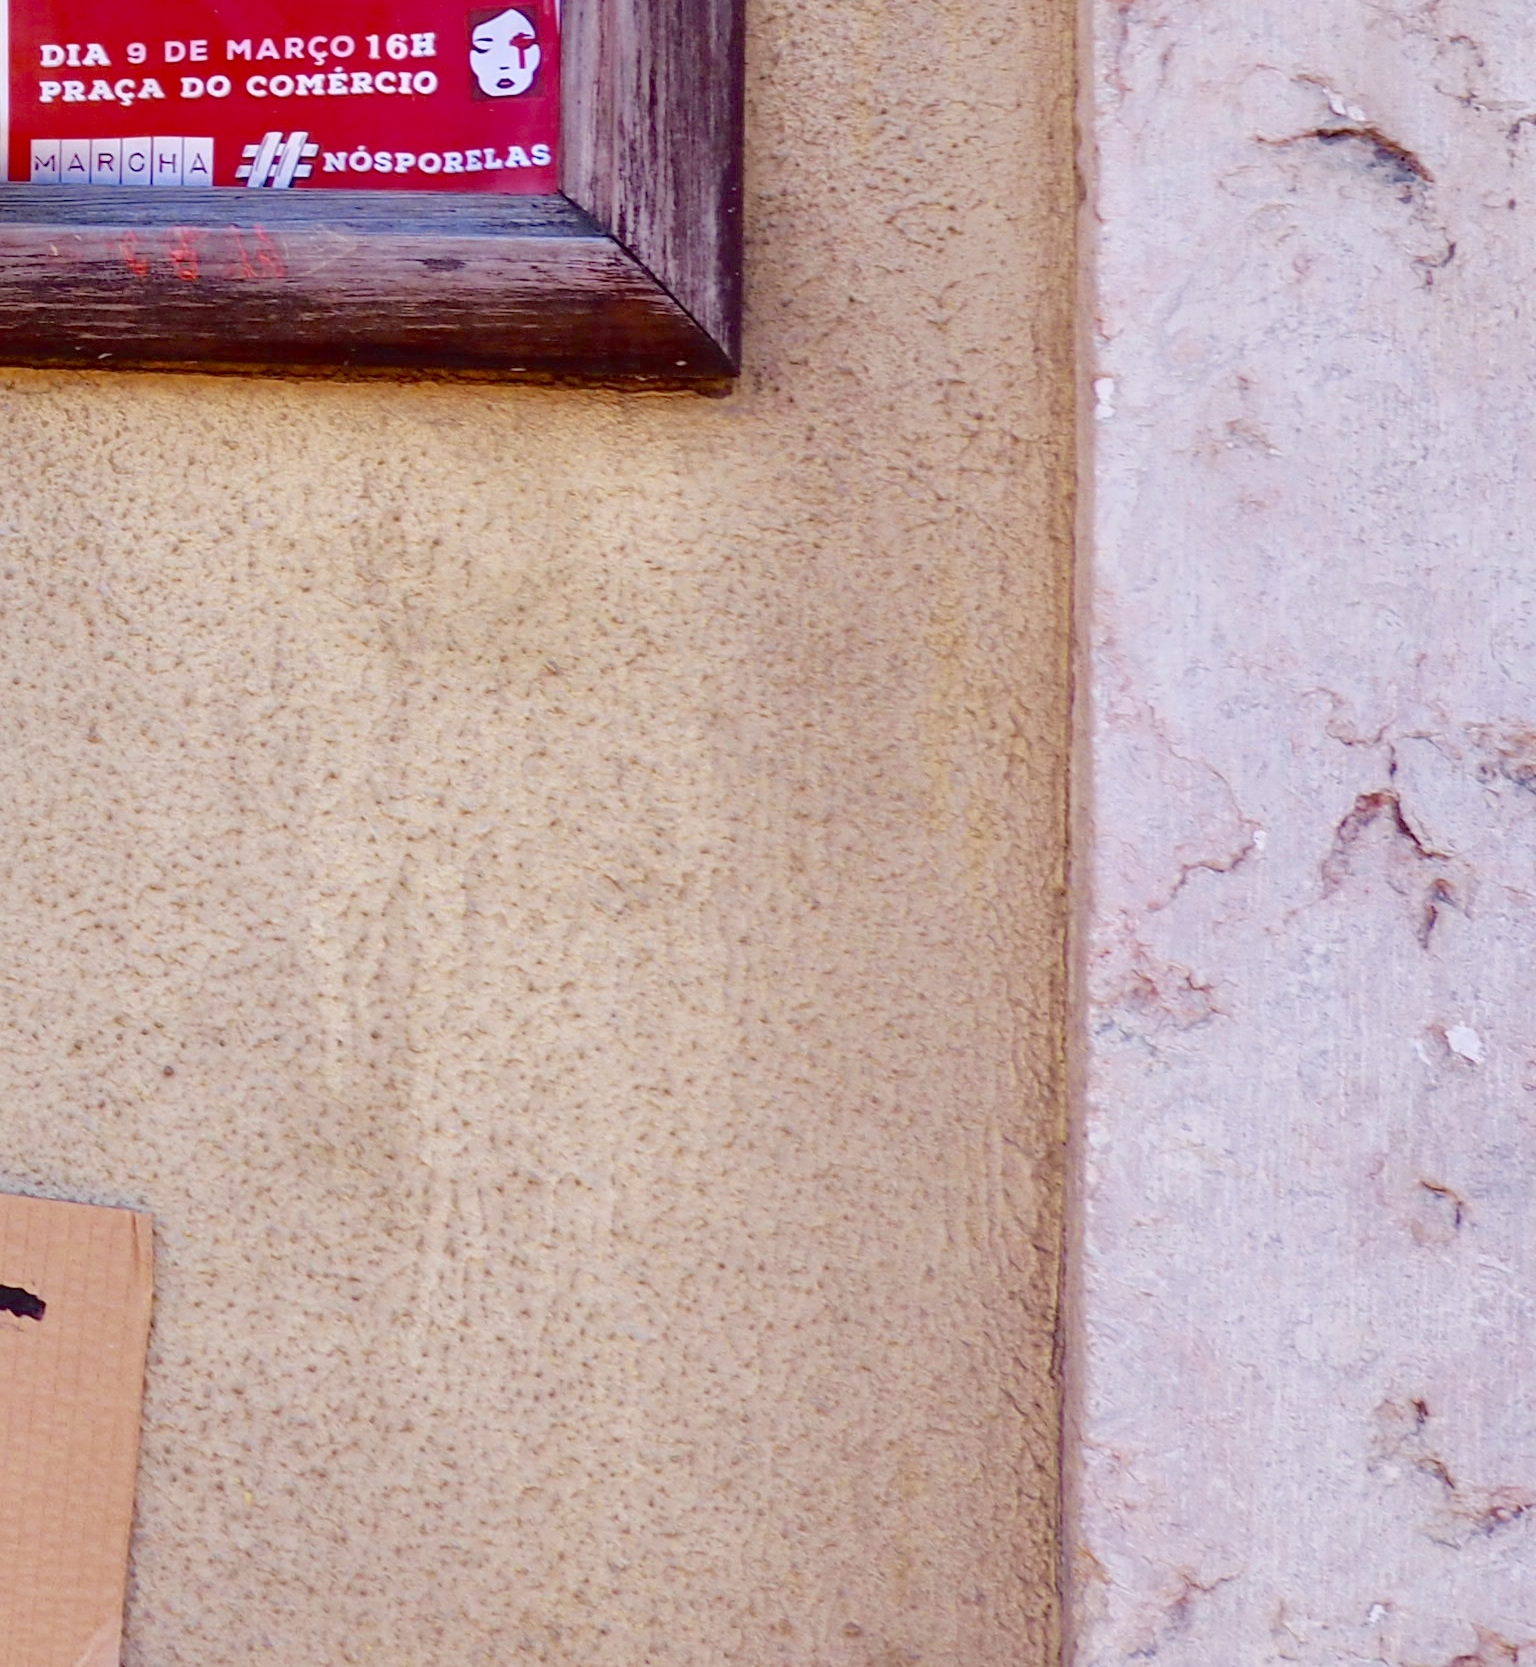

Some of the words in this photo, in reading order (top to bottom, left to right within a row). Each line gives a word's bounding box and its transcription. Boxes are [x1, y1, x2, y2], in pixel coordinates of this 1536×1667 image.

[40, 42, 112, 69] DIA
[127, 40, 148, 65] 9
[164, 38, 209, 64] DE
[225, 35, 355, 66] MARÇO
[366, 32, 436, 61] 16H
[39, 77, 166, 105] PRAÇA
[179, 75, 232, 99] DO
[245, 67, 439, 98] COMÉRCIO
[33, 151, 209, 175] MARCHA
